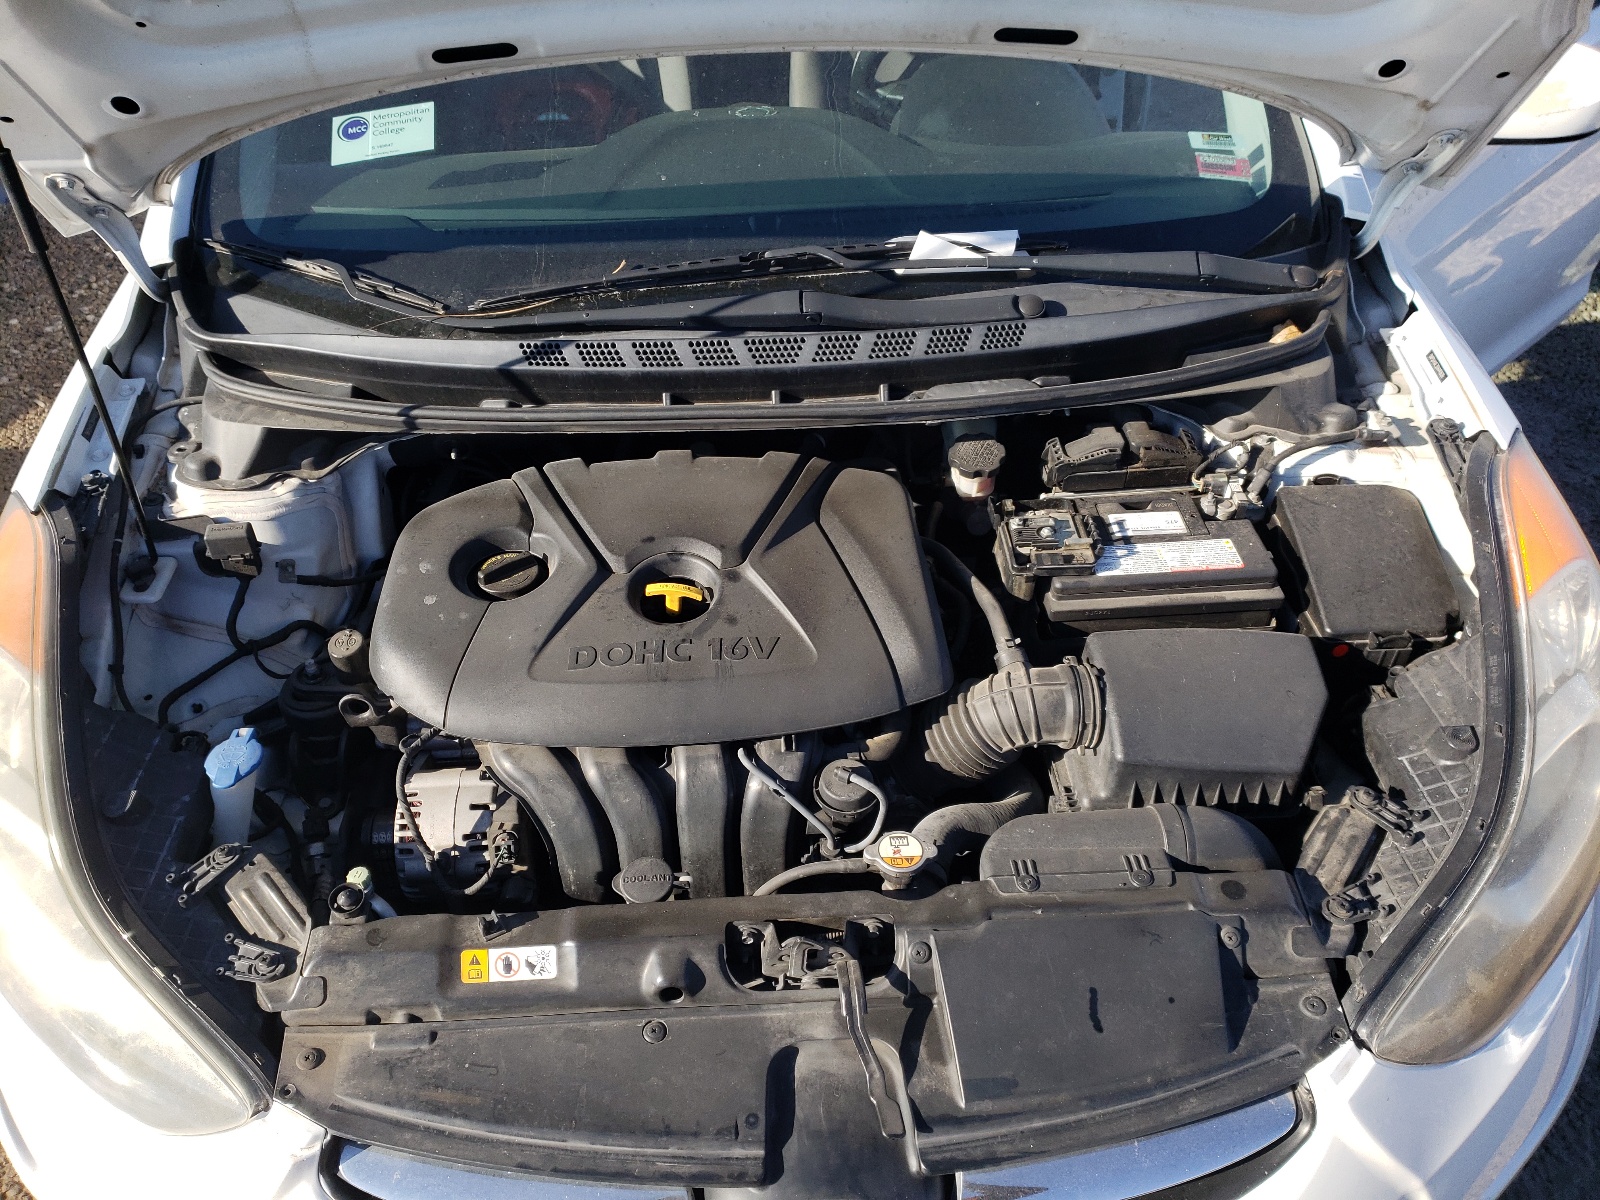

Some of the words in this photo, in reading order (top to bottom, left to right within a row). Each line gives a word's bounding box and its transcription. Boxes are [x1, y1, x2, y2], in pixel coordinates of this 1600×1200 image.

[373, 107, 430, 121] Metropolitan
[373, 116, 423, 129] Community
[347, 125, 367, 135] MCC
[373, 126, 405, 137] College
[568, 639, 693, 671] DOHC
[707, 636, 781, 661] 16V
[623, 873, 671, 884] COOLANT
